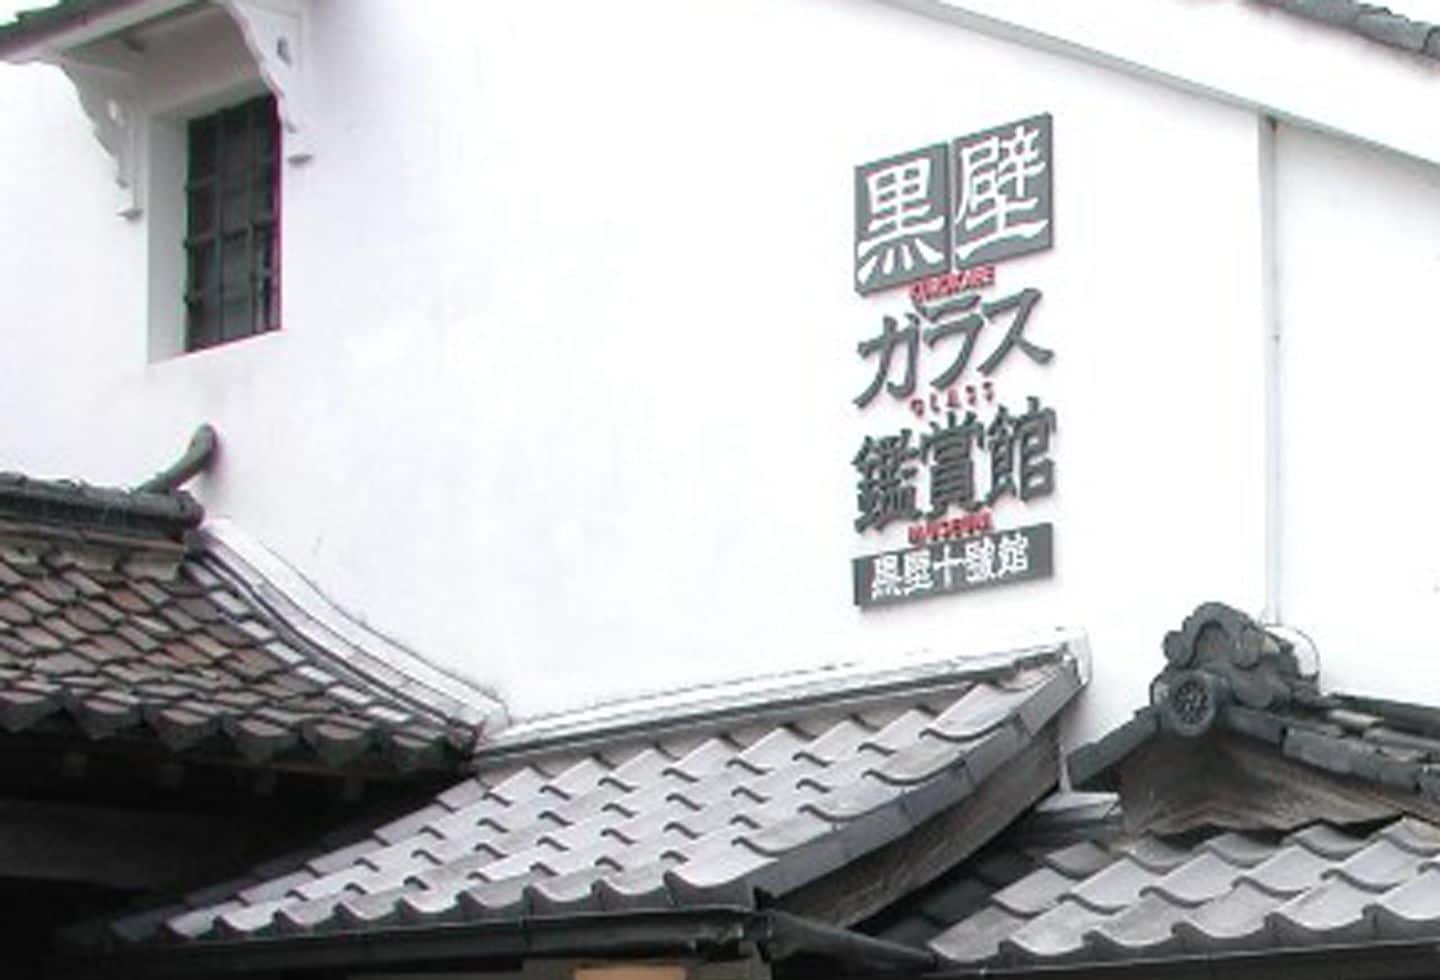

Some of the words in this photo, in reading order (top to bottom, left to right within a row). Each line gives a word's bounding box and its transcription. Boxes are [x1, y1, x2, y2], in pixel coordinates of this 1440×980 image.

[857, 124, 1049, 286] 黒壁
[853, 288, 1055, 410] ガラス
[851, 396, 1057, 533] 鑑賞館
